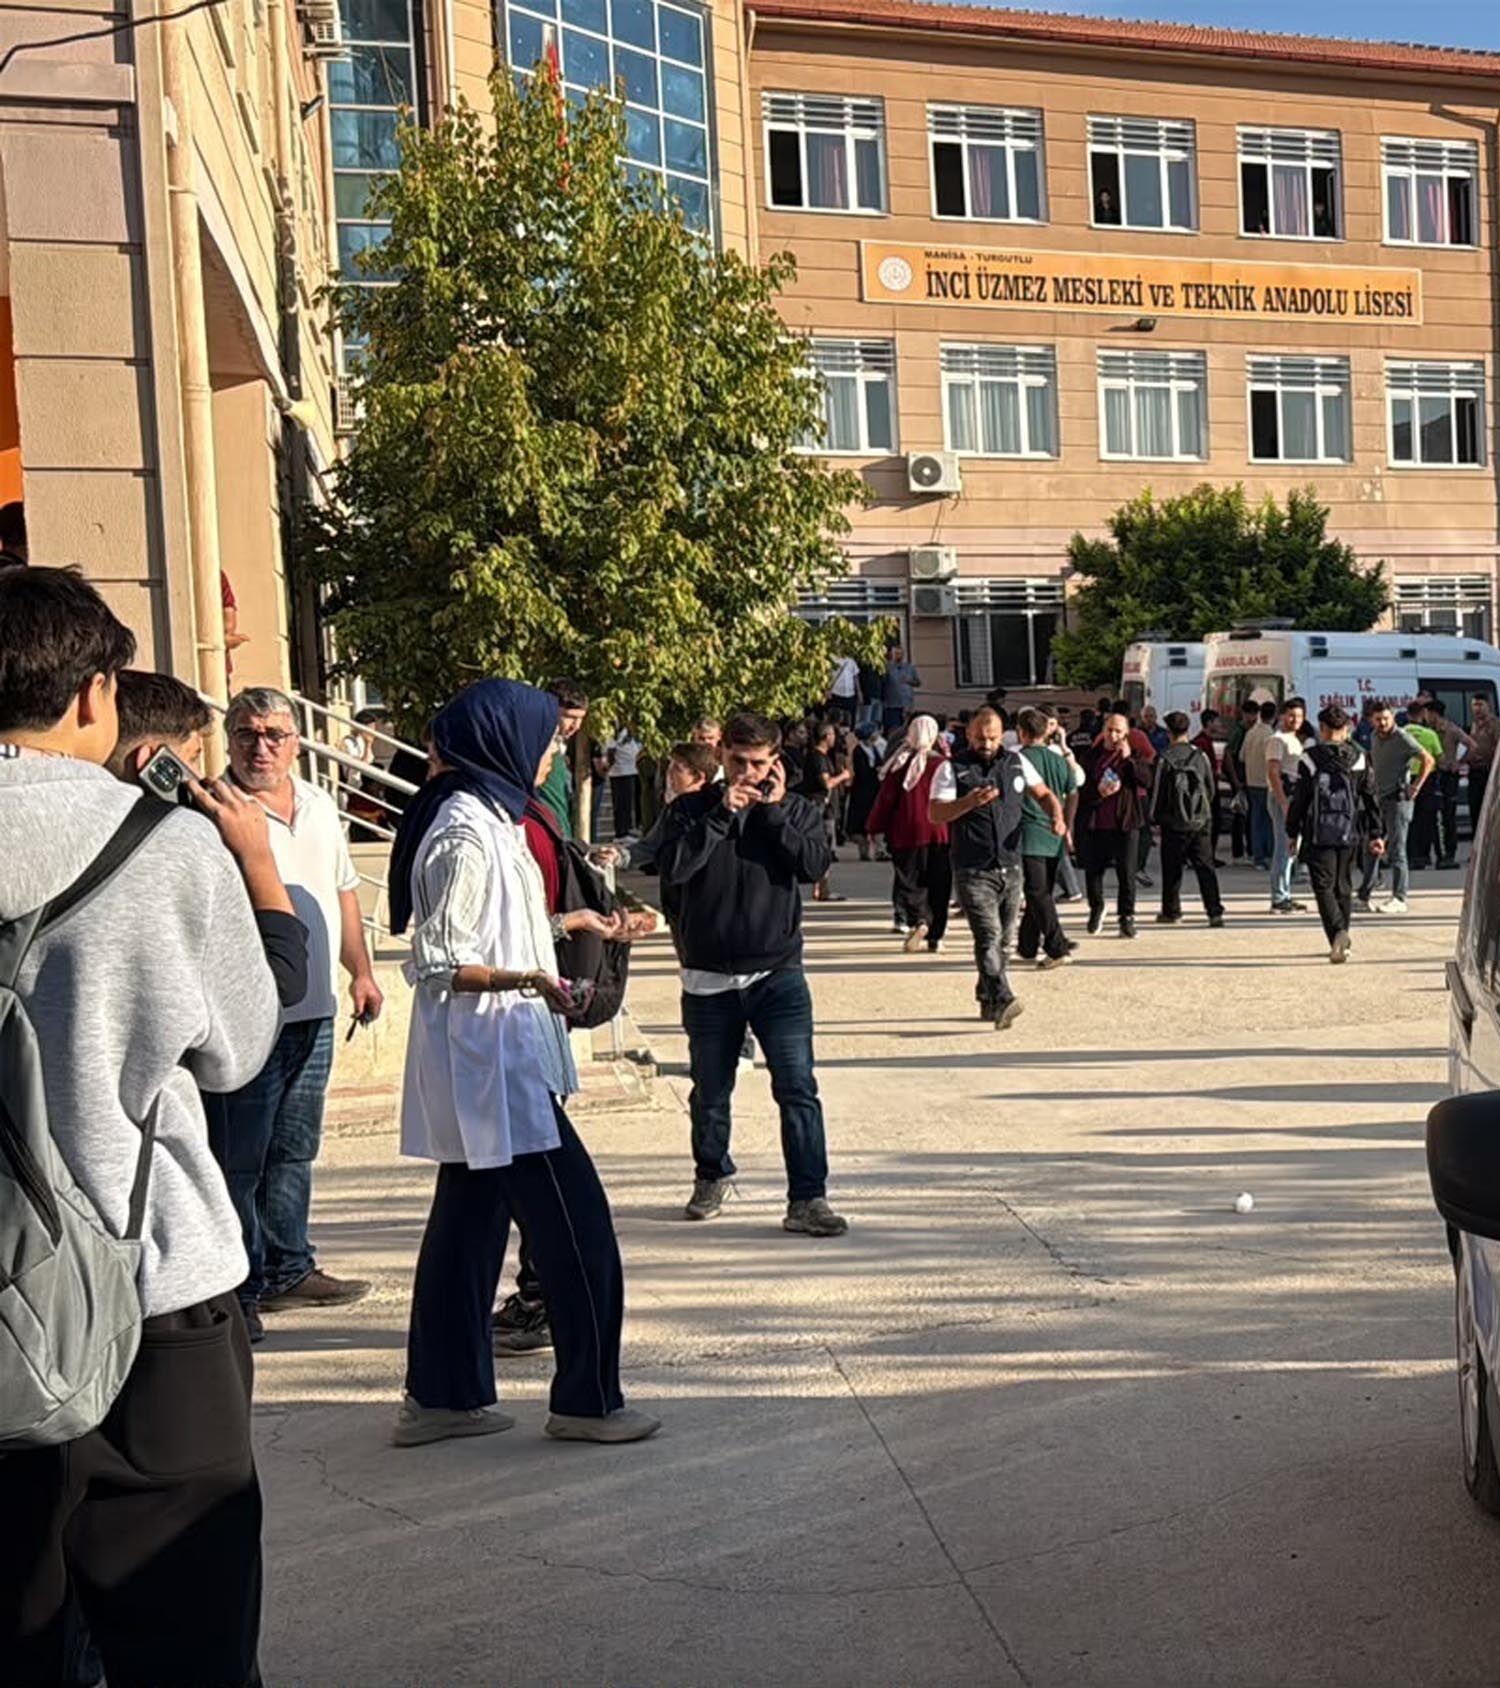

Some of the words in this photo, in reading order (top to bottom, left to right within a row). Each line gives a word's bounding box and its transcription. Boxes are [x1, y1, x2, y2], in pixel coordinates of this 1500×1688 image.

[924, 251, 966, 261] MANİSA
[975, 254, 1033, 265] TURGUTLU
[926, 263, 970, 299] İNCİ
[976, 266, 1047, 302] ÜZMEZ
[1053, 274, 1143, 306] MESLEKİ
[1149, 283, 1174, 308] VE
[1181, 279, 1257, 311] TEKNİK
[1263, 286, 1349, 316] ANADOLU
[1354, 285, 1413, 317] LİSESİ
